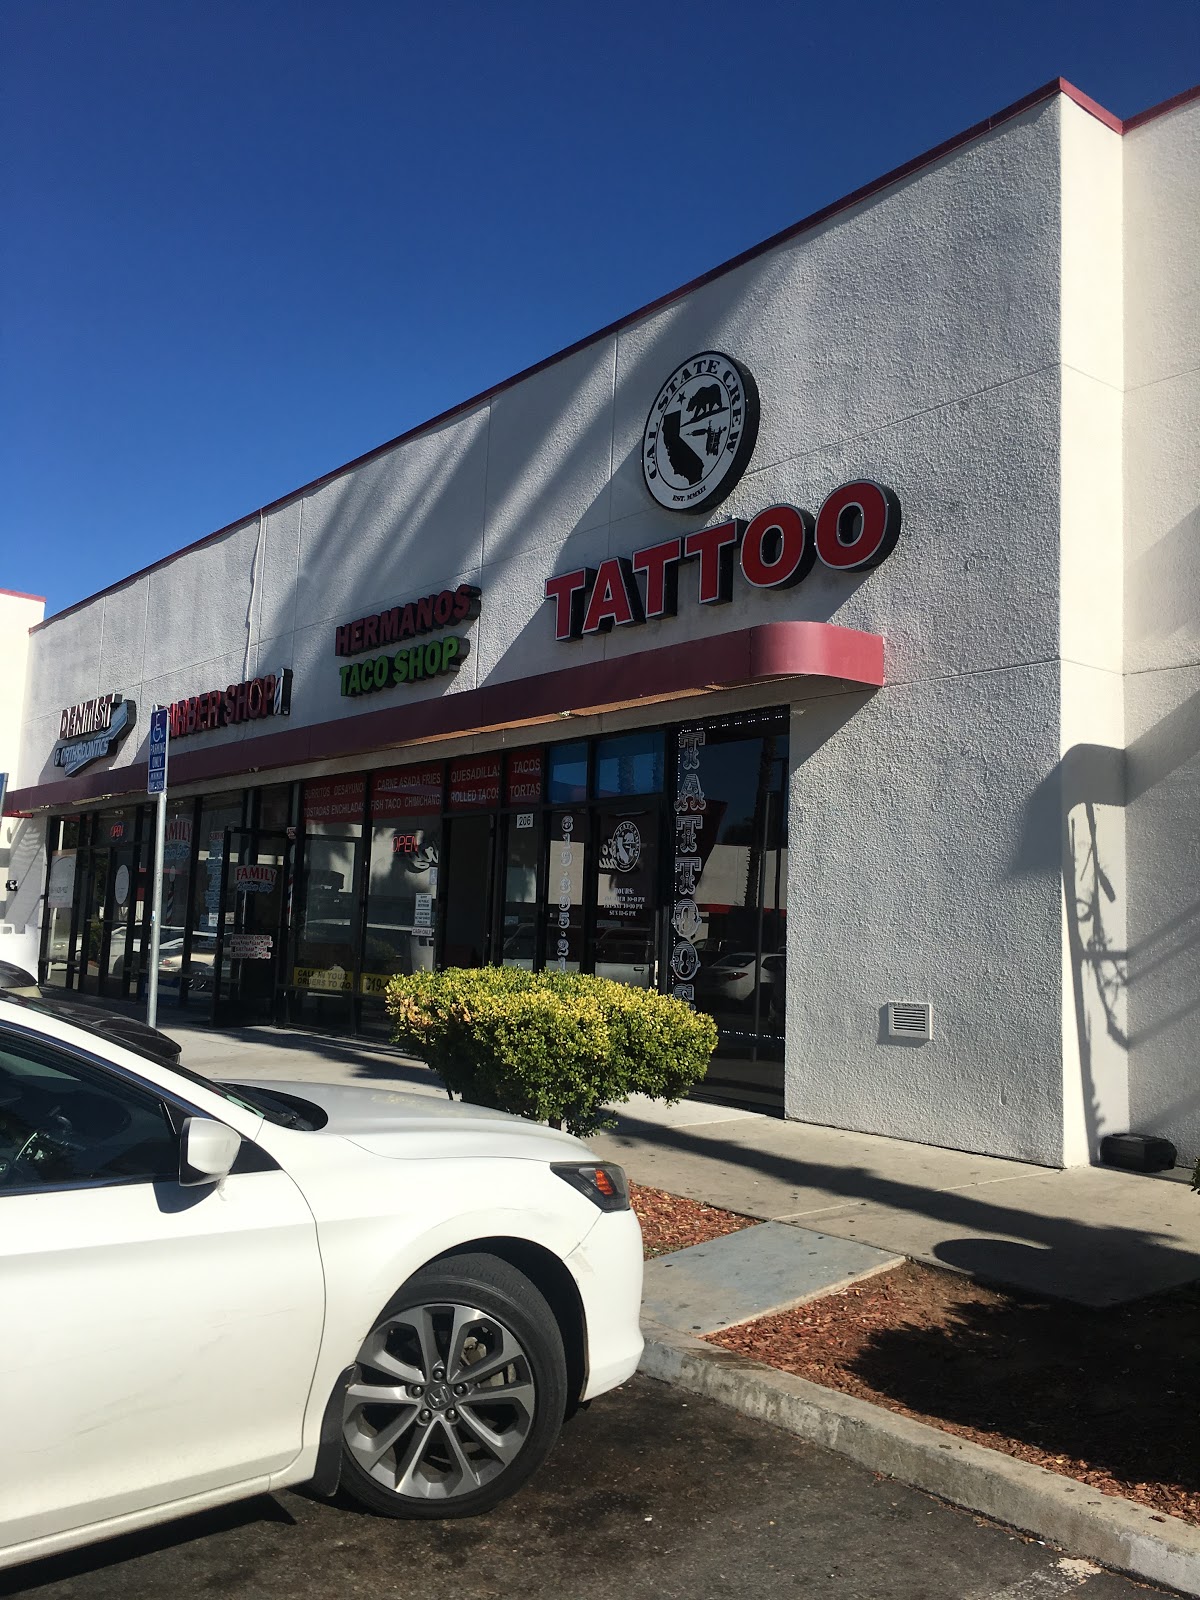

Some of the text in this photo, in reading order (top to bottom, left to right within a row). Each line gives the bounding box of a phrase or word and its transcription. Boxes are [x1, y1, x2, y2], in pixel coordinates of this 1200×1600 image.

[658, 359, 721, 413] STATE
[722, 370, 742, 454] CREW
[544, 478, 896, 642] TATTOO
[335, 584, 475, 656] HERMANOS
[339, 635, 461, 696] TACO SHOP
[169, 674, 276, 738] ARBER SHOP
[58, 692, 116, 740] DENTIST
[513, 758, 541, 774] TACOS
[377, 773, 441, 790] CARNE ASADA FRIES
[304, 786, 331, 800] BURRITOS
[450, 789, 477, 803] ROLLED
[510, 782, 541, 798] TORTAS
[370, 799, 384, 811] FISH
[385, 797, 402, 810] TACO
[391, 835, 419, 854] OPEN
[236, 866, 276, 882] FAMILY
[297, 977, 326, 987] ORDERS
[328, 980, 338, 988] TO
[327, 972, 349, 981] YOUR
